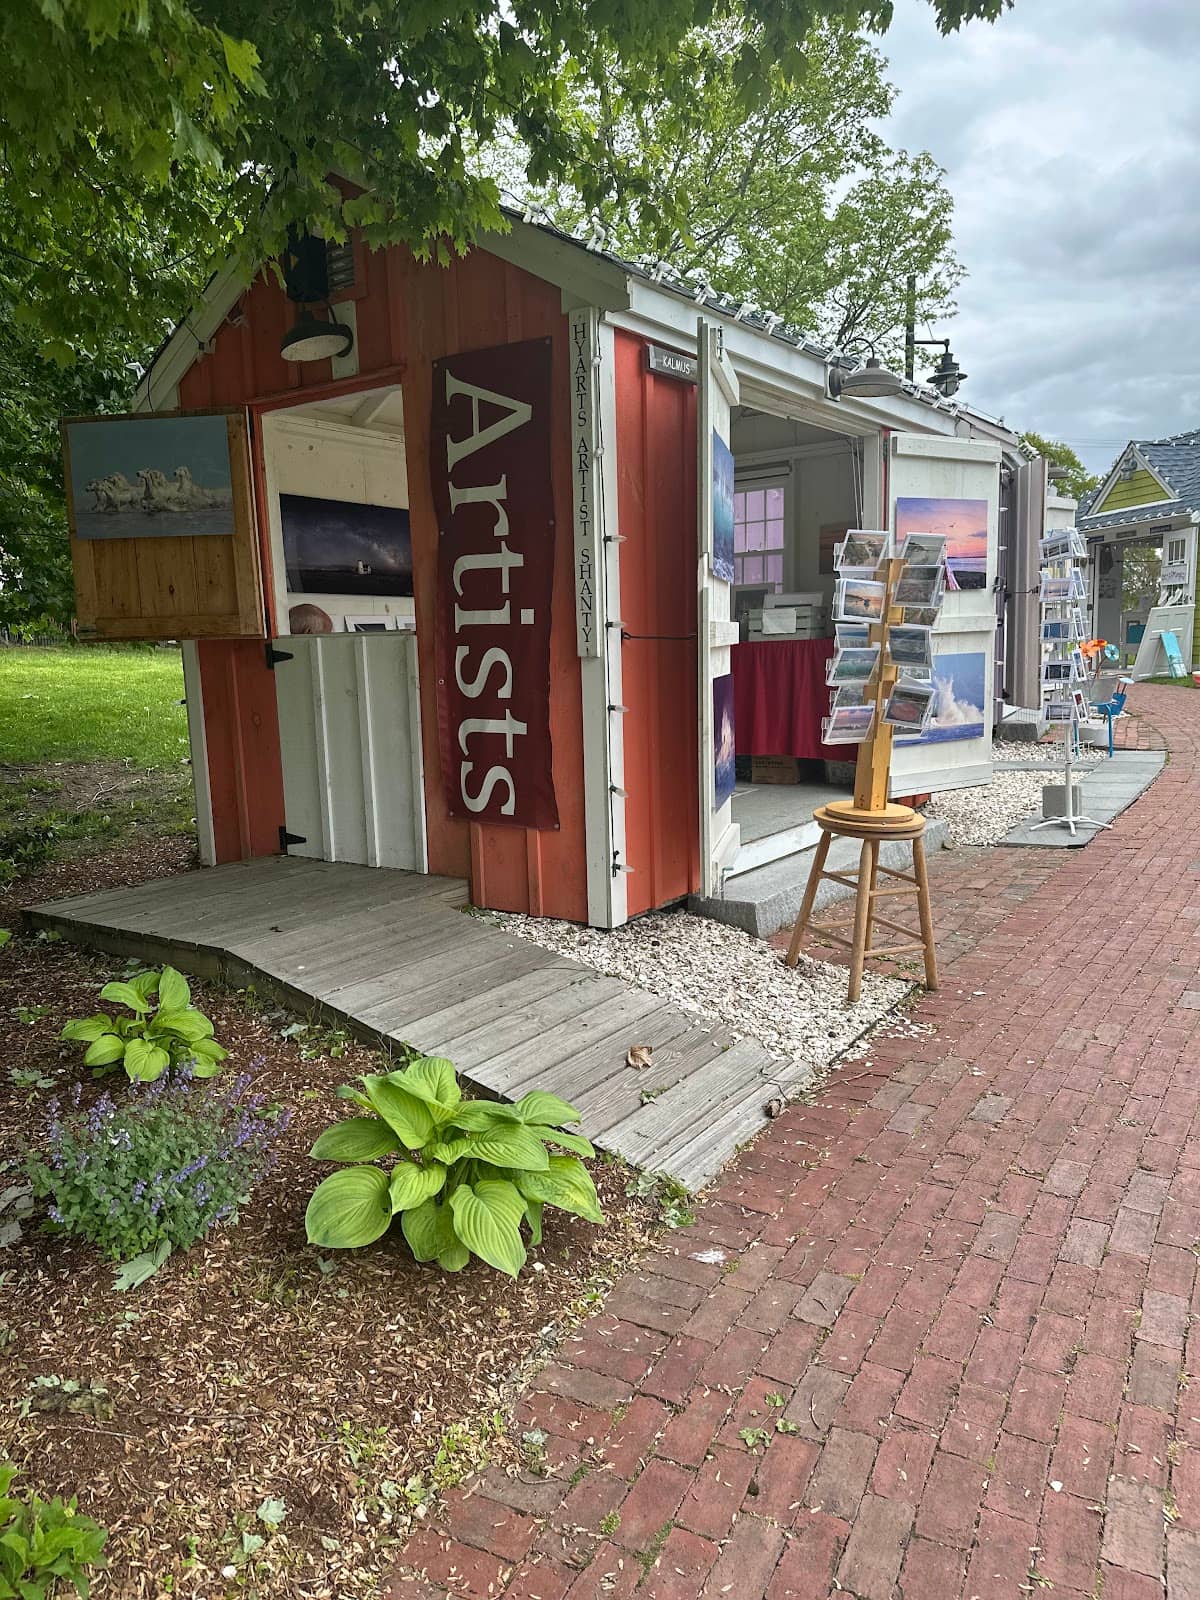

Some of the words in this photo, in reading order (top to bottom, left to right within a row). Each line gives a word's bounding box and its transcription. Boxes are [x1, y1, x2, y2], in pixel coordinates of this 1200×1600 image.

[572, 323, 587, 427] HYARTS
[662, 355, 691, 374] KALMUS
[576, 436, 590, 537] ARTIST
[444, 368, 535, 816] Artists
[579, 549, 593, 643] SHANTY
